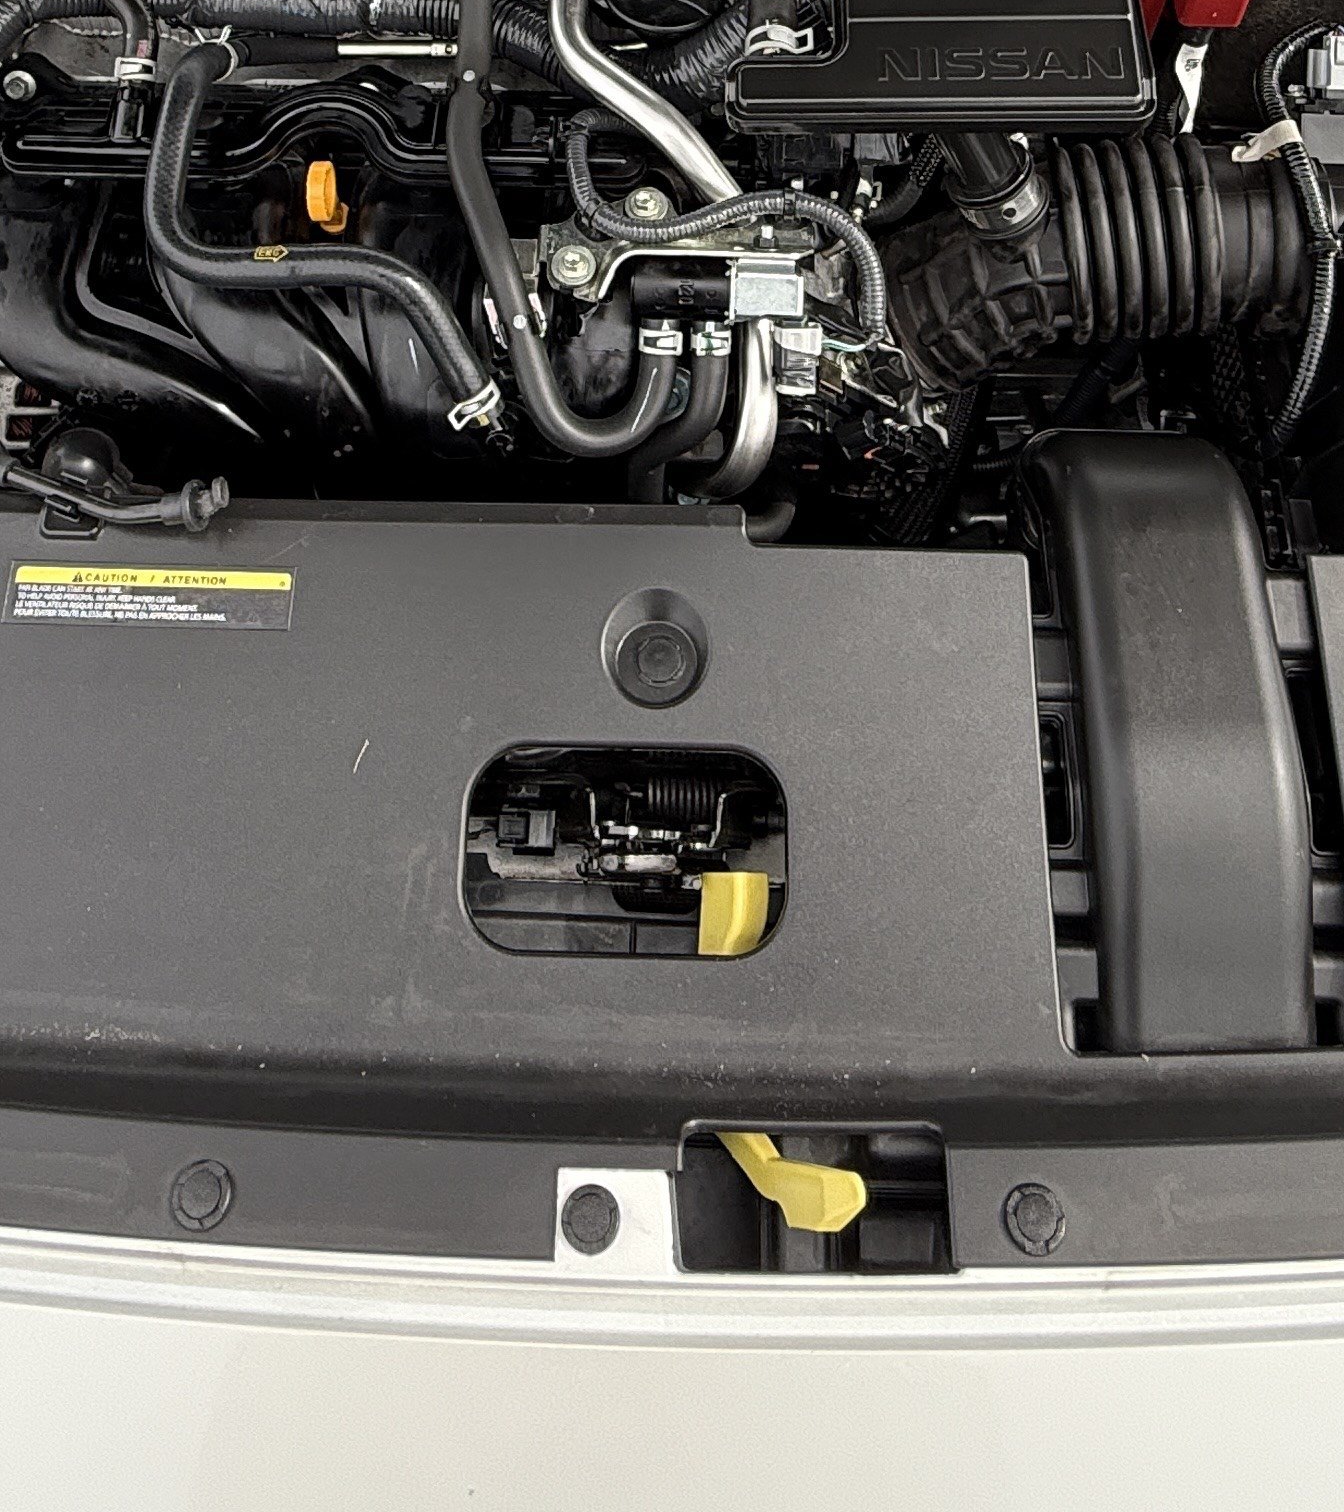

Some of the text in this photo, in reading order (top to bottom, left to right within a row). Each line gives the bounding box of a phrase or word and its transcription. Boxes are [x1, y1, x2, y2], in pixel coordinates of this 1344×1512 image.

[877, 44, 1126, 83] NISSAN
[85, 573, 138, 582] CAUTION
[163, 576, 227, 585] ATTENTION
